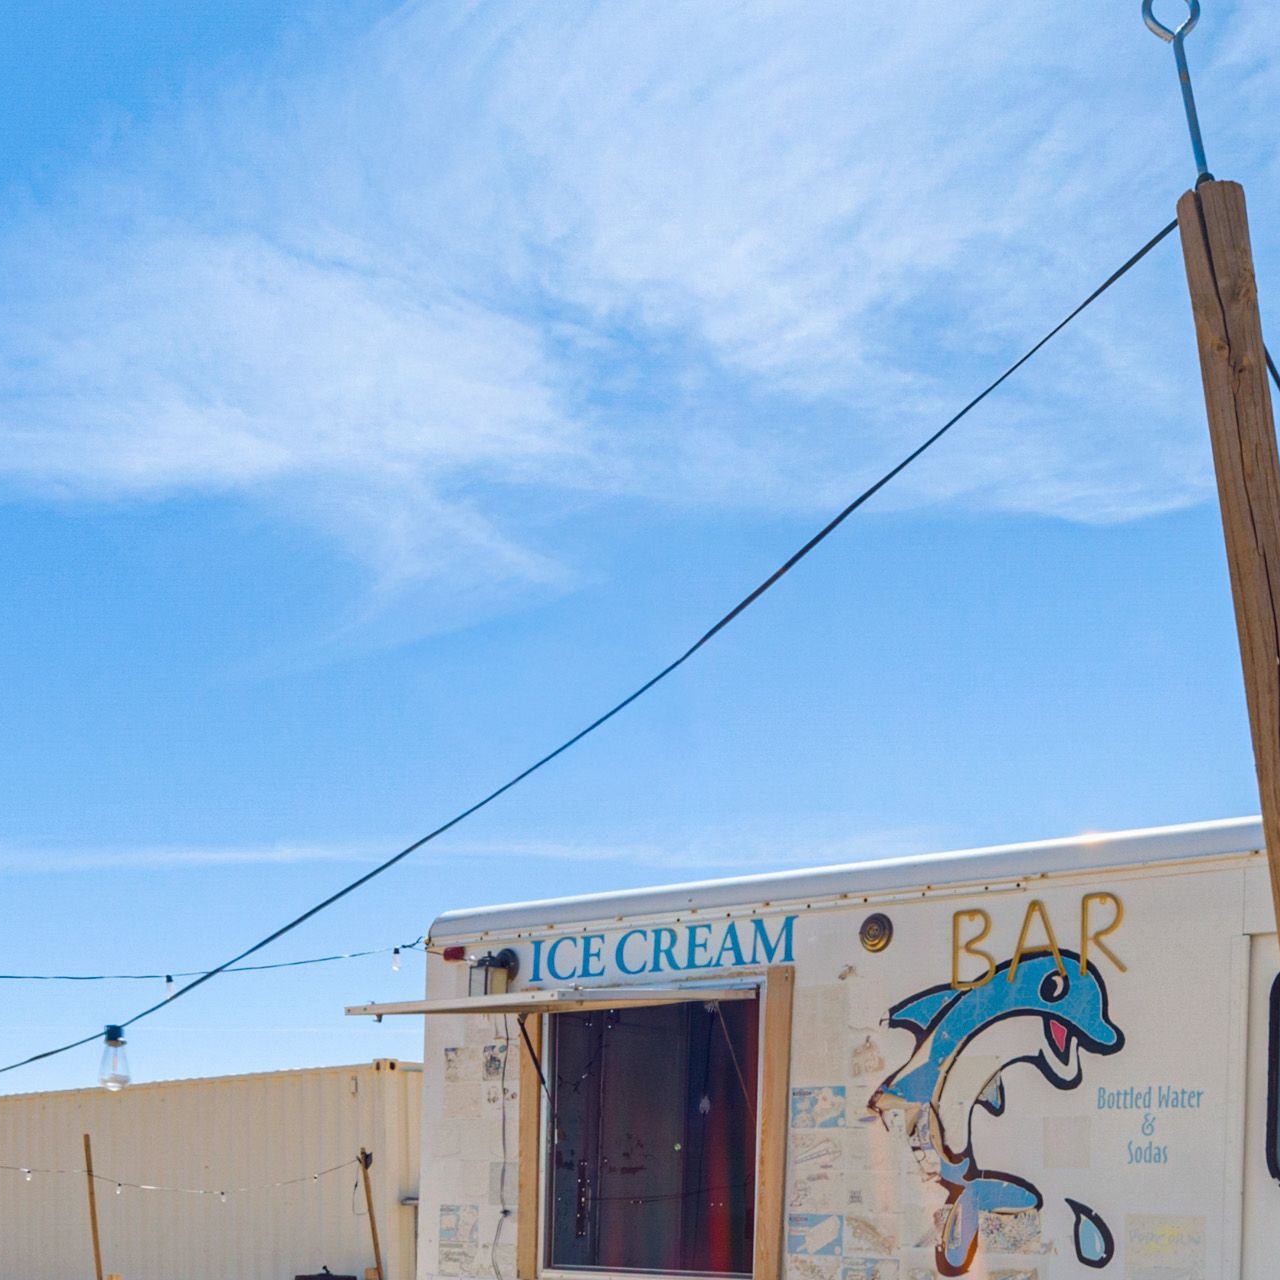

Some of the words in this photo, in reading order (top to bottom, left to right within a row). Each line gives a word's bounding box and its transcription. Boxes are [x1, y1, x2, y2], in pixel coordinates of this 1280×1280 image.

[528, 933, 606, 982] ICE
[614, 914, 799, 976] CREAM
[951, 891, 1128, 989] BAR
[1096, 1085, 1152, 1110] Bottled
[1157, 1084, 1204, 1109] Water
[1141, 1112, 1157, 1137] &
[1127, 1140, 1169, 1165] Sodas
